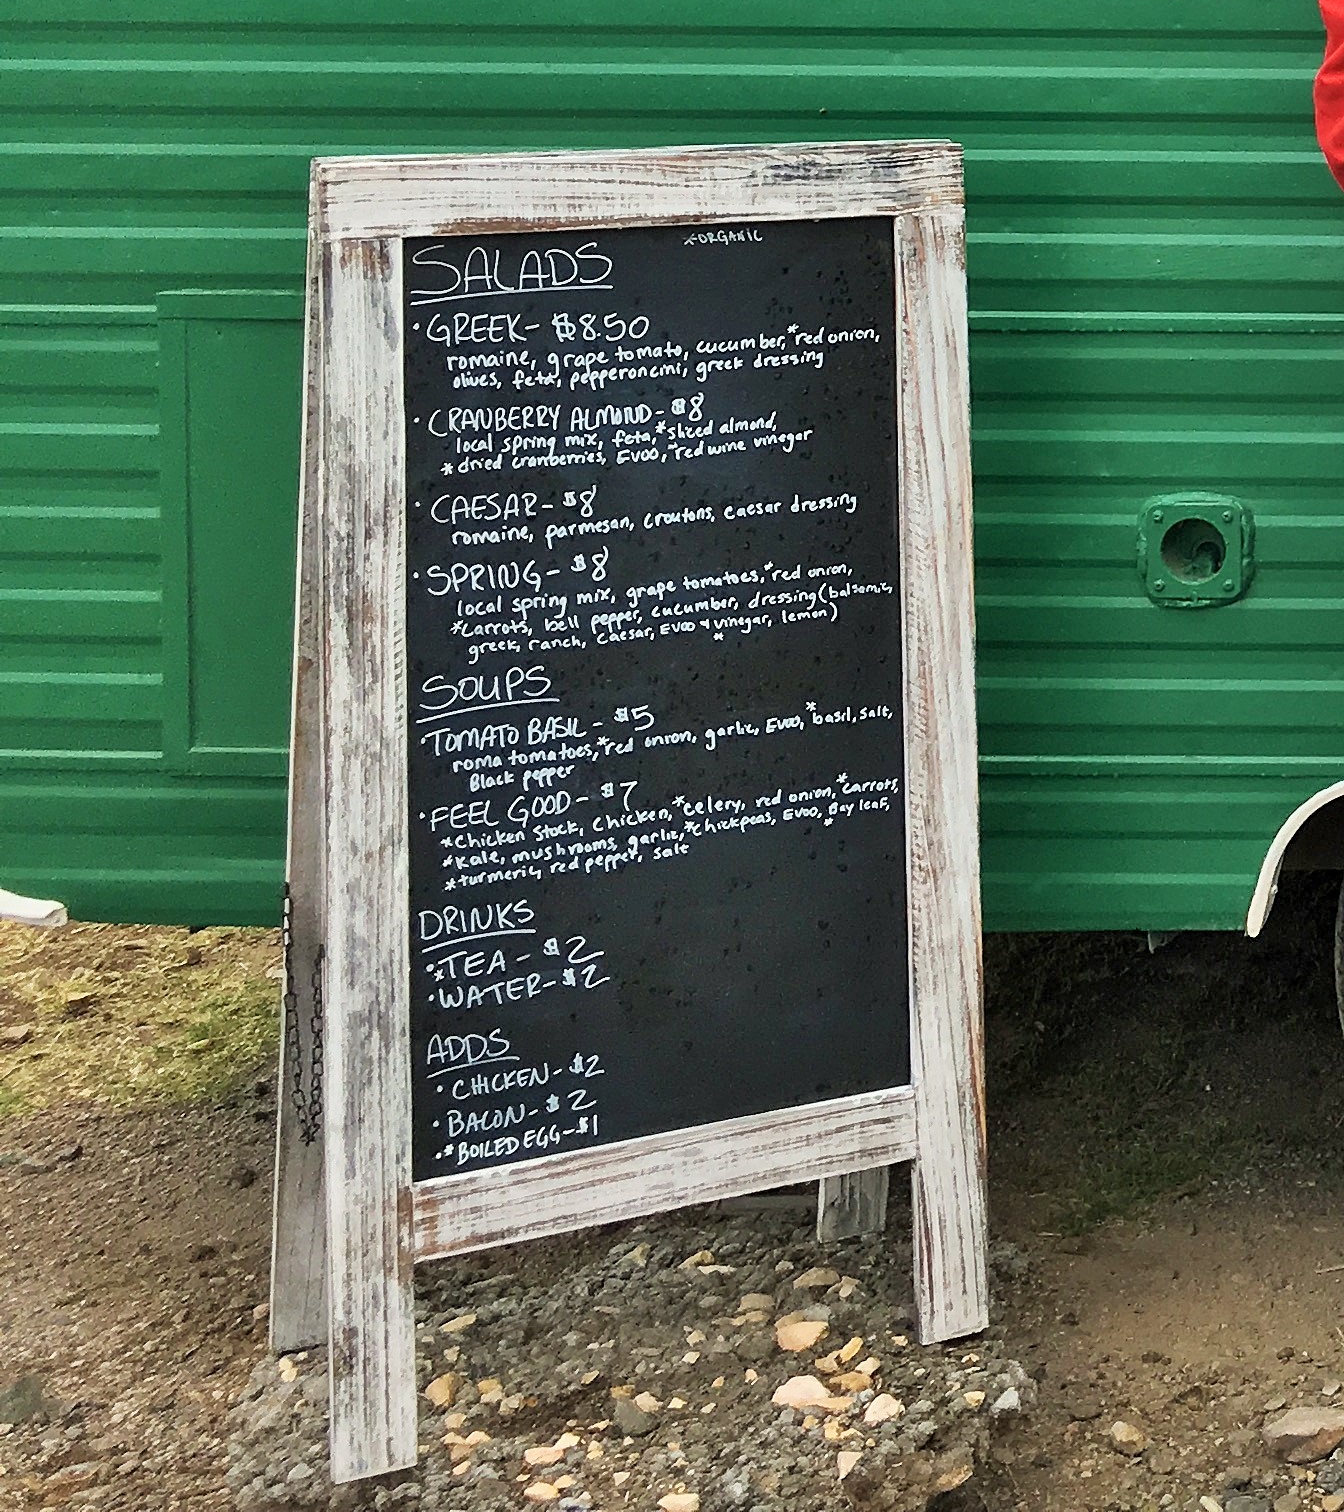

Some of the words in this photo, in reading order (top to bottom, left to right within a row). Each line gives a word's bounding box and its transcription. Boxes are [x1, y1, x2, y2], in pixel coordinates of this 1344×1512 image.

[411, 242, 613, 295] SALADS
[447, 351, 536, 371] romaine,
[548, 350, 609, 378] grape
[616, 341, 688, 362] tomato,
[696, 333, 786, 355] cucumber,
[828, 328, 880, 344] onion,
[453, 371, 501, 389] olives,
[512, 370, 562, 387] feta,
[696, 358, 743, 382] greek
[753, 350, 824, 369] dressing
[428, 404, 561, 437] CRANBERRY
[456, 432, 493, 454] local
[501, 434, 556, 458] spring
[565, 433, 604, 450] mix,
[512, 451, 606, 469] cranberries,
[707, 440, 746, 456] wine
[753, 430, 813, 453] vinegar
[562, 485, 597, 518] $8
[451, 526, 534, 545] romaine,
[545, 513, 634, 549] parmesan,
[791, 493, 857, 513] dressing
[571, 546, 609, 582] $8
[457, 595, 501, 617] local
[512, 593, 568, 620] spring
[576, 588, 615, 605] mix,
[626, 580, 676, 608] grape
[683, 570, 765, 591] tomatoes,
[529, 636, 586, 652] ranch,
[714, 614, 772, 633] vinegar,
[545, 615, 579, 632] bell
[590, 609, 642, 635] pepper,
[419, 666, 552, 710] SOUPS
[614, 706, 655, 731] $5
[452, 754, 502, 773] roma
[508, 744, 599, 766] tomatoes,
[523, 765, 575, 791] pepper
[430, 799, 499, 832] FEEL
[600, 781, 638, 812] $7
[755, 789, 782, 808] red
[550, 857, 579, 874] red
[418, 899, 535, 940] DRINKS
[562, 964, 611, 989] $2
[426, 1028, 510, 1065] ADDS
[569, 1053, 605, 1078] $2
[457, 1136, 520, 1166] BOILED
